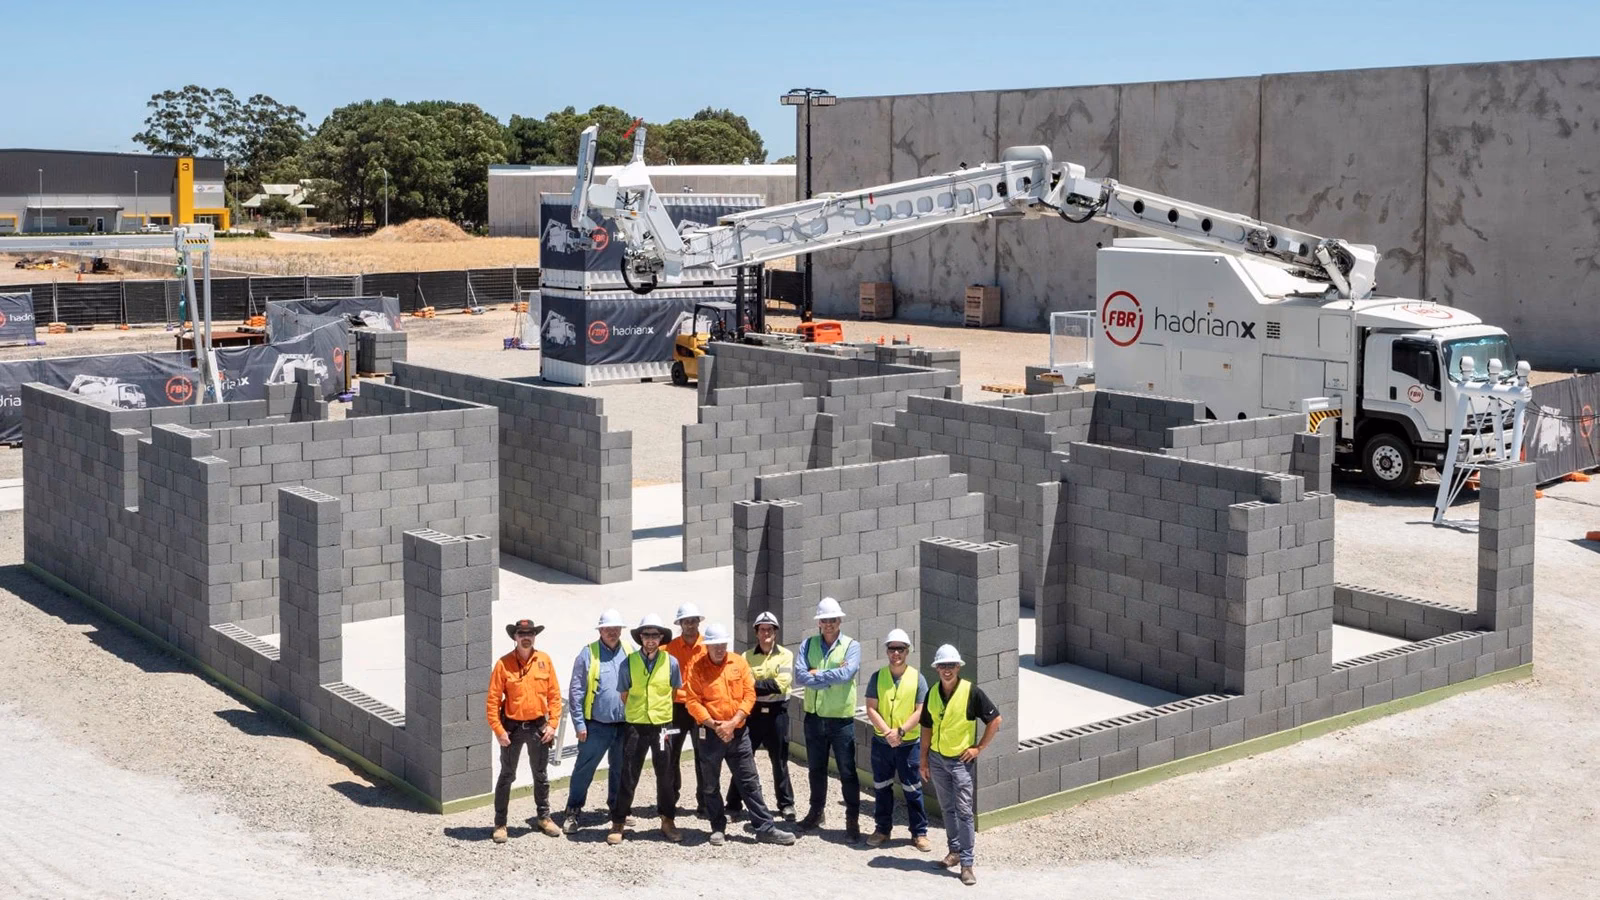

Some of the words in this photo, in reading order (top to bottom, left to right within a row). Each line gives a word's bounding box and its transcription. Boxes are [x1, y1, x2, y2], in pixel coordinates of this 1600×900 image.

[182, 163, 190, 171] 3
[1108, 310, 1137, 328] FBR
[1154, 306, 1257, 340] hadrianx
[612, 325, 655, 336] hadrianx
[169, 384, 190, 394] FBR
